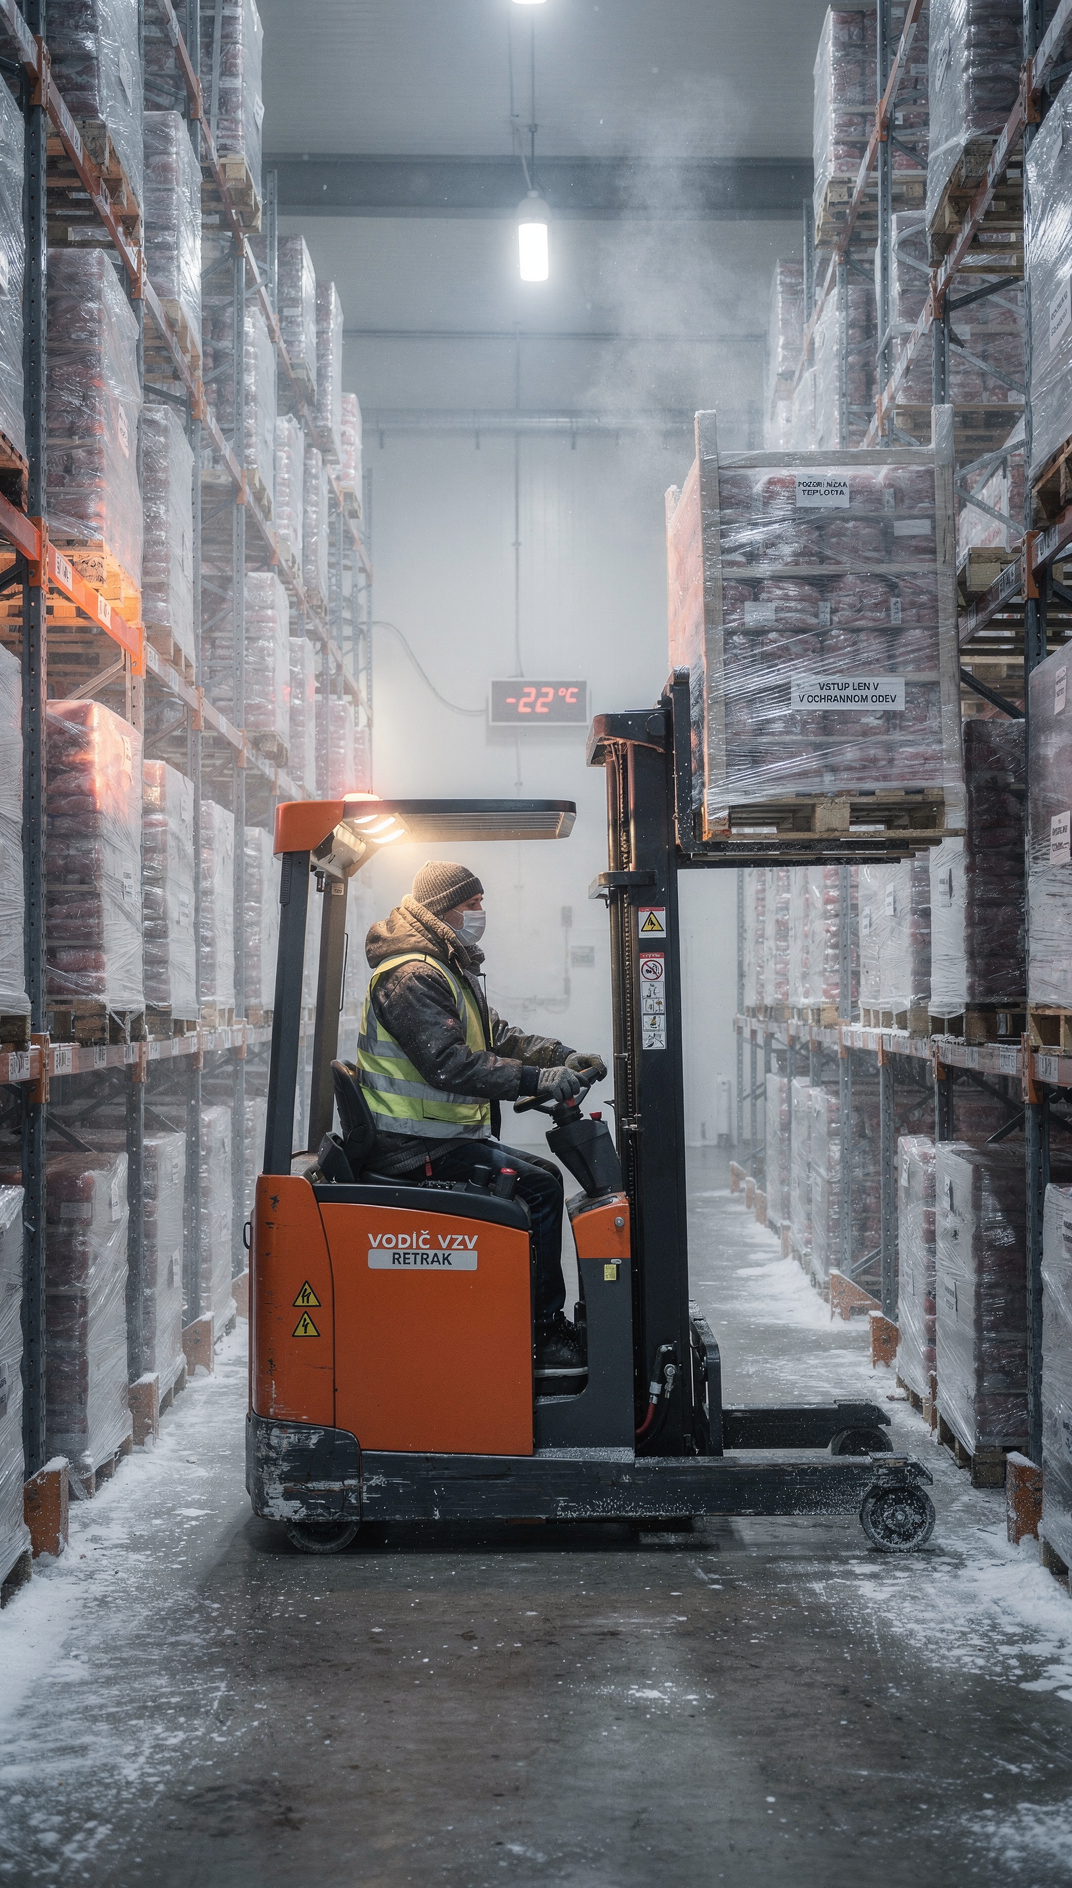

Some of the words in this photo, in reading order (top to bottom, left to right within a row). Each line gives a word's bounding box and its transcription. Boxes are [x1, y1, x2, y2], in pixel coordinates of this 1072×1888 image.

[818, 682, 850, 691] VSTUP
[852, 682, 871, 691] LEN
[872, 682, 880, 691] V
[798, 694, 805, 703] V
[806, 694, 869, 703] OCHRANNOM
[870, 694, 897, 703] ODEV
[437, 1234, 478, 1249] VZV
[391, 1252, 453, 1265] RETRAK
